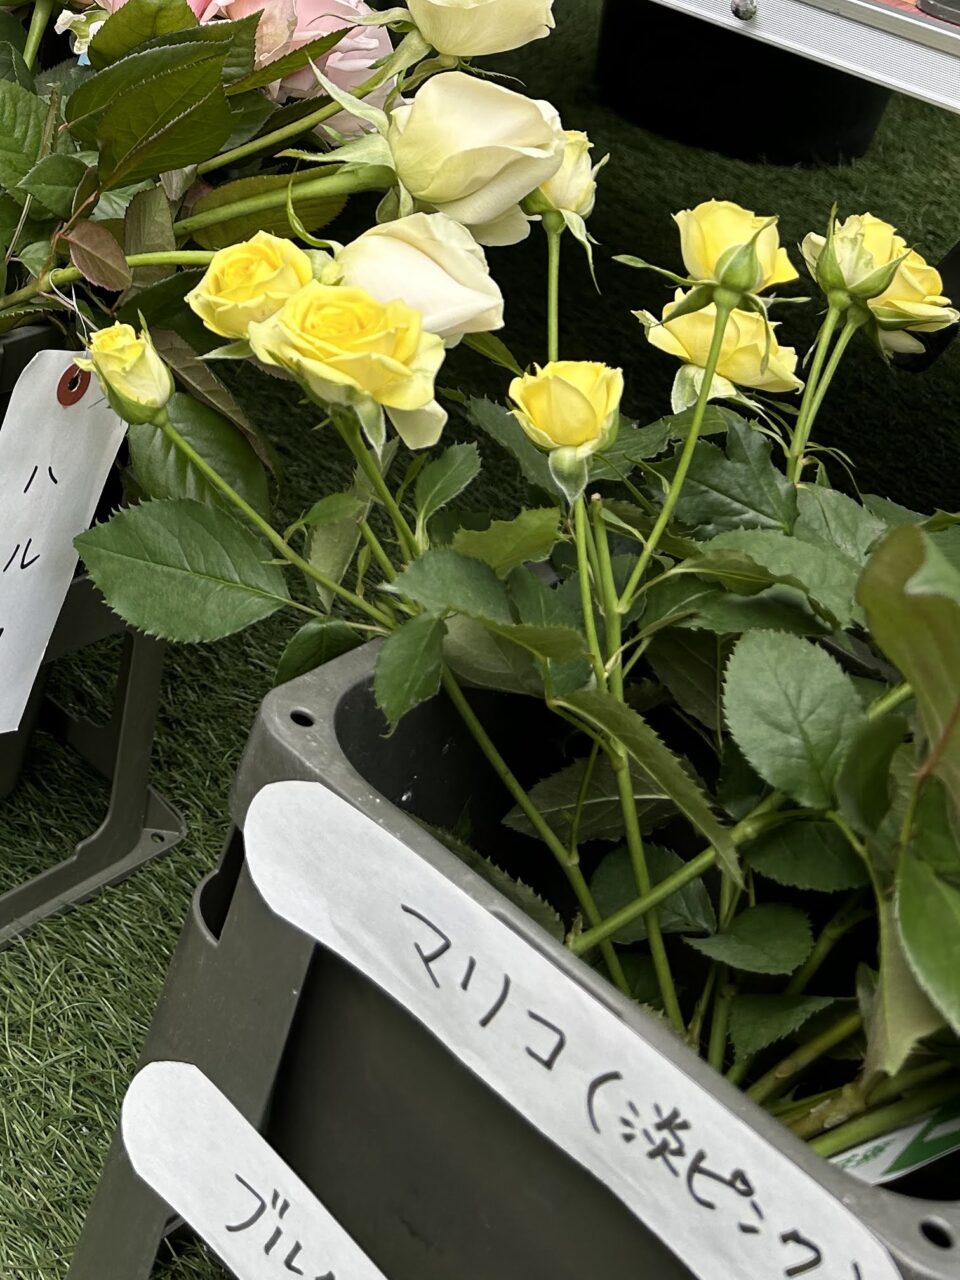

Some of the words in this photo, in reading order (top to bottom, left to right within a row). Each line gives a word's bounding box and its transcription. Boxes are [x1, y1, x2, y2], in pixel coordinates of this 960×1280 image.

[400, 904, 864, 1280] マリコ(淡ピンク
